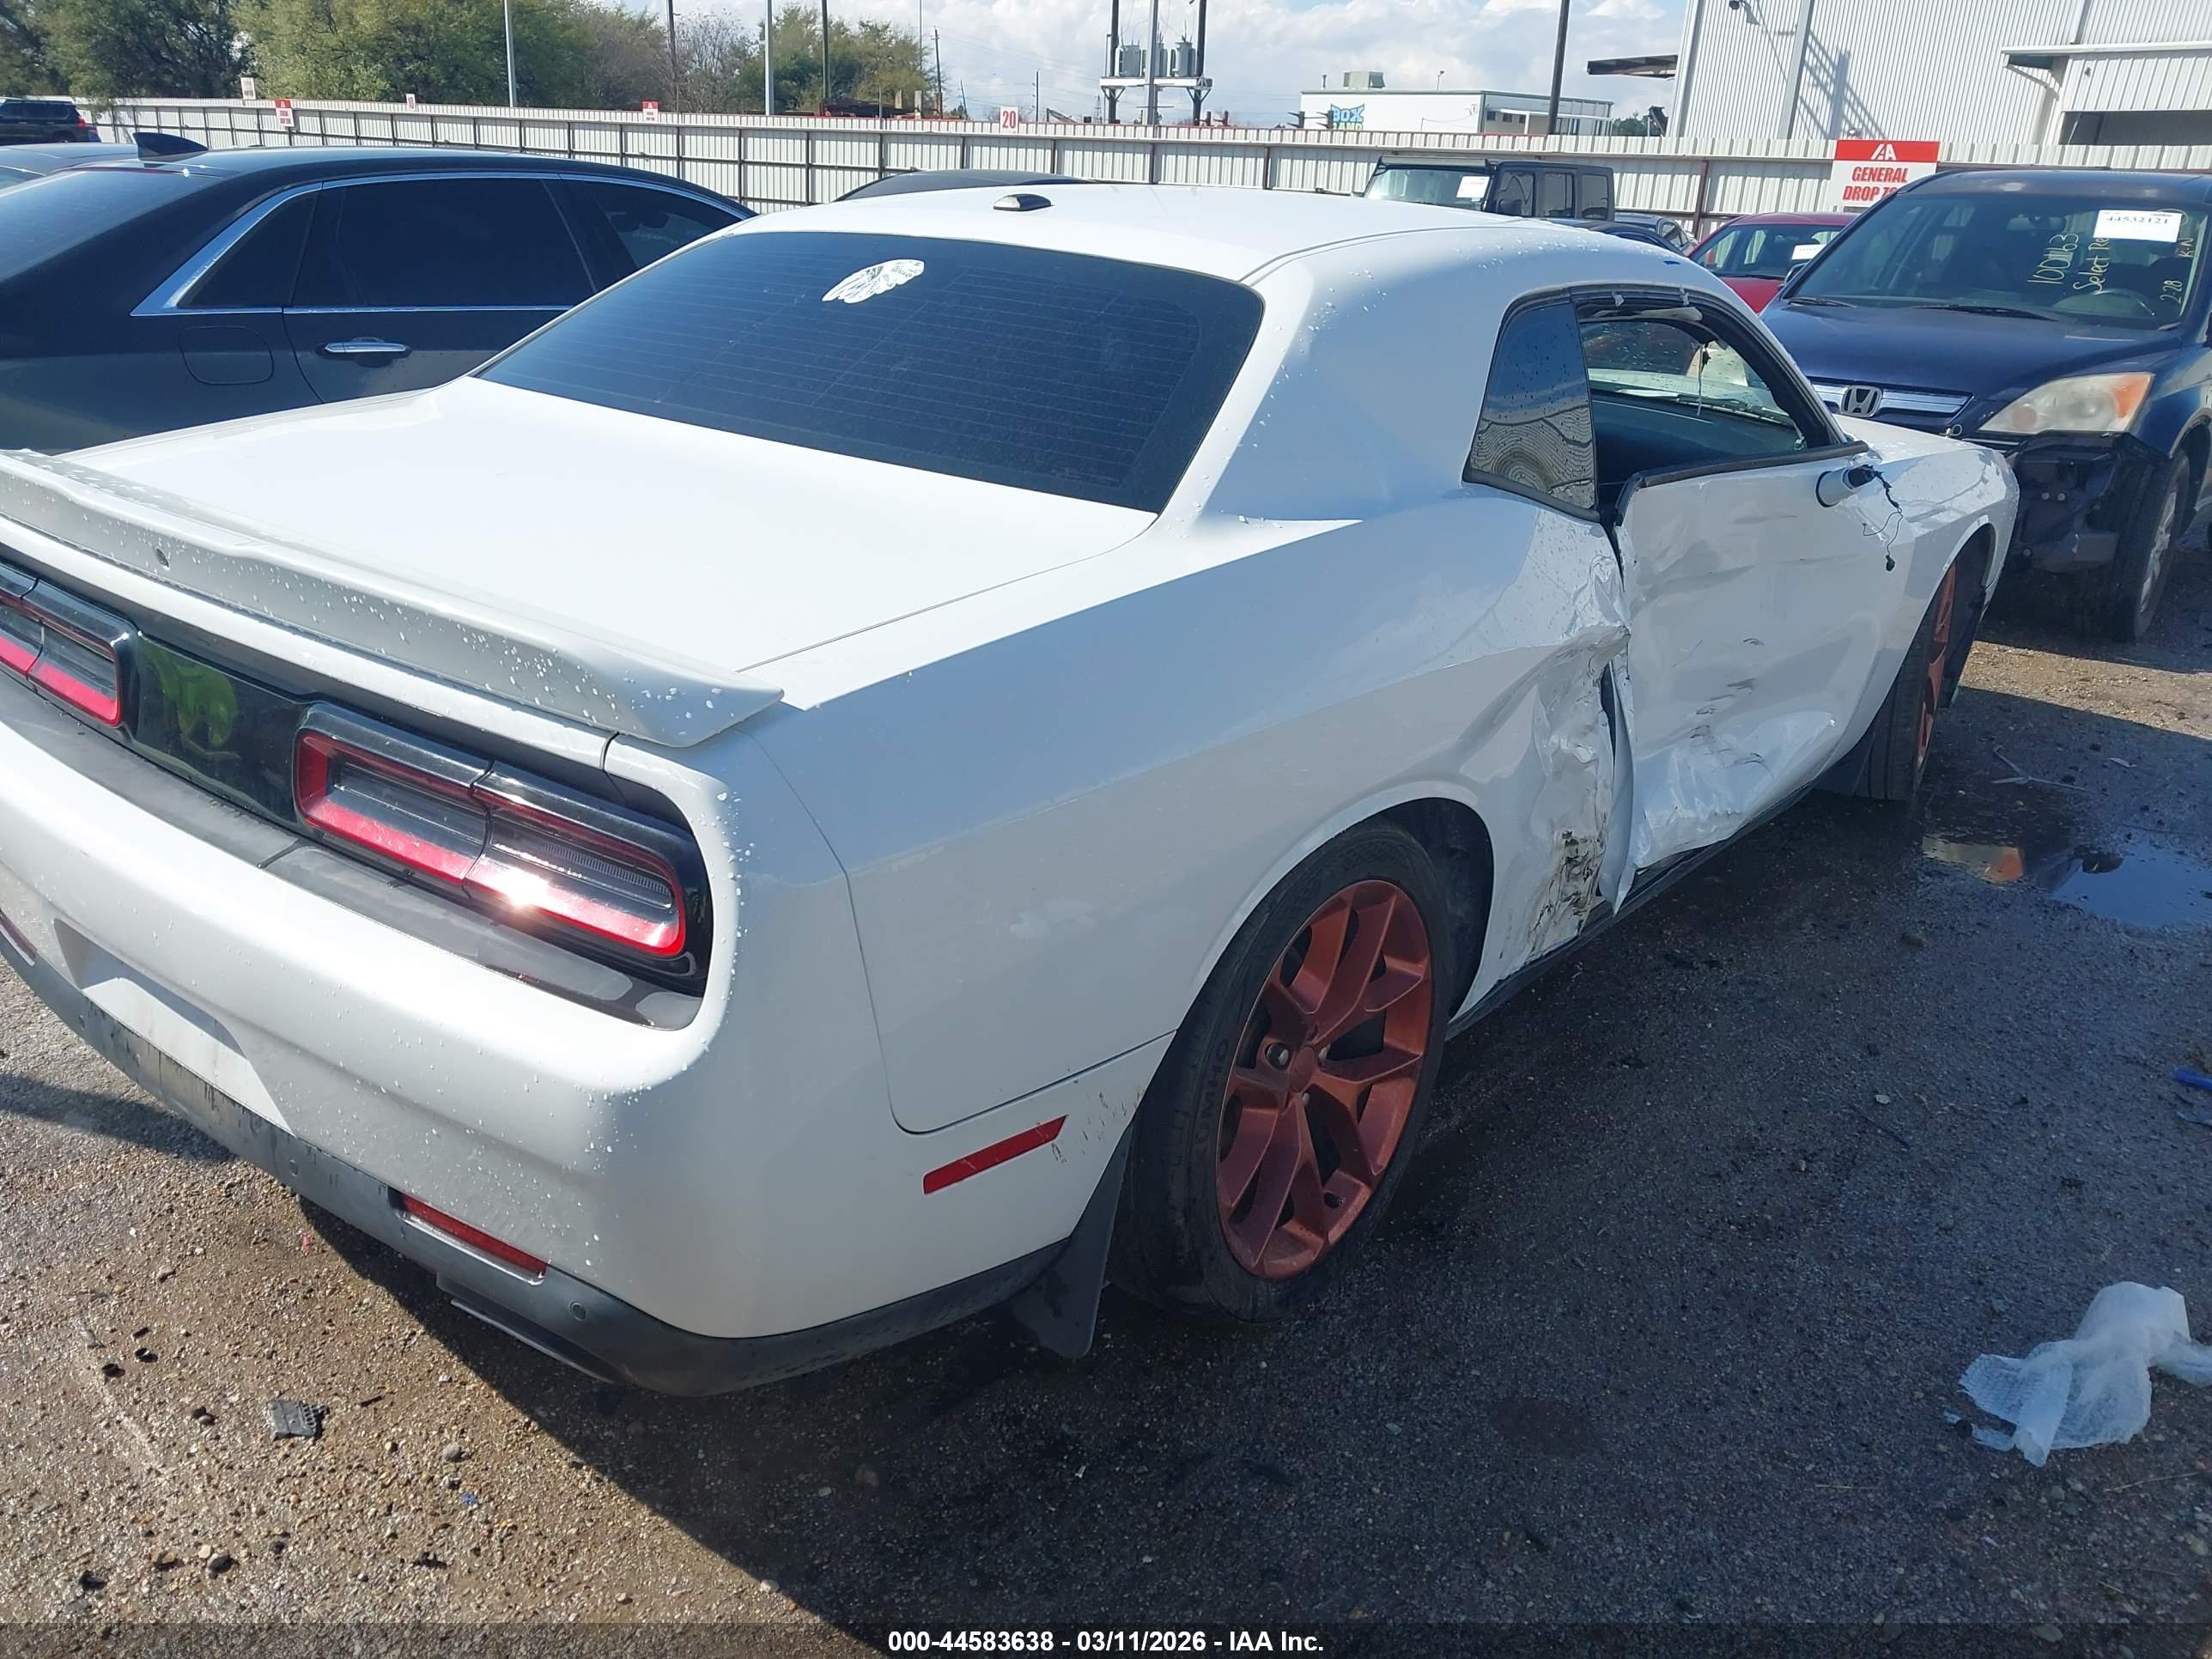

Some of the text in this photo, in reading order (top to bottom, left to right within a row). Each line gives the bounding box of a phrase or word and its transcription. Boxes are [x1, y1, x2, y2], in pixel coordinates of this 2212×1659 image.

[1002, 110, 1017, 129] 20
[1331, 103, 1364, 122] BOX
[1851, 166, 1909, 183] GENERAL
[1842, 185, 1880, 201] DROP
[2073, 255, 2110, 295] Select
